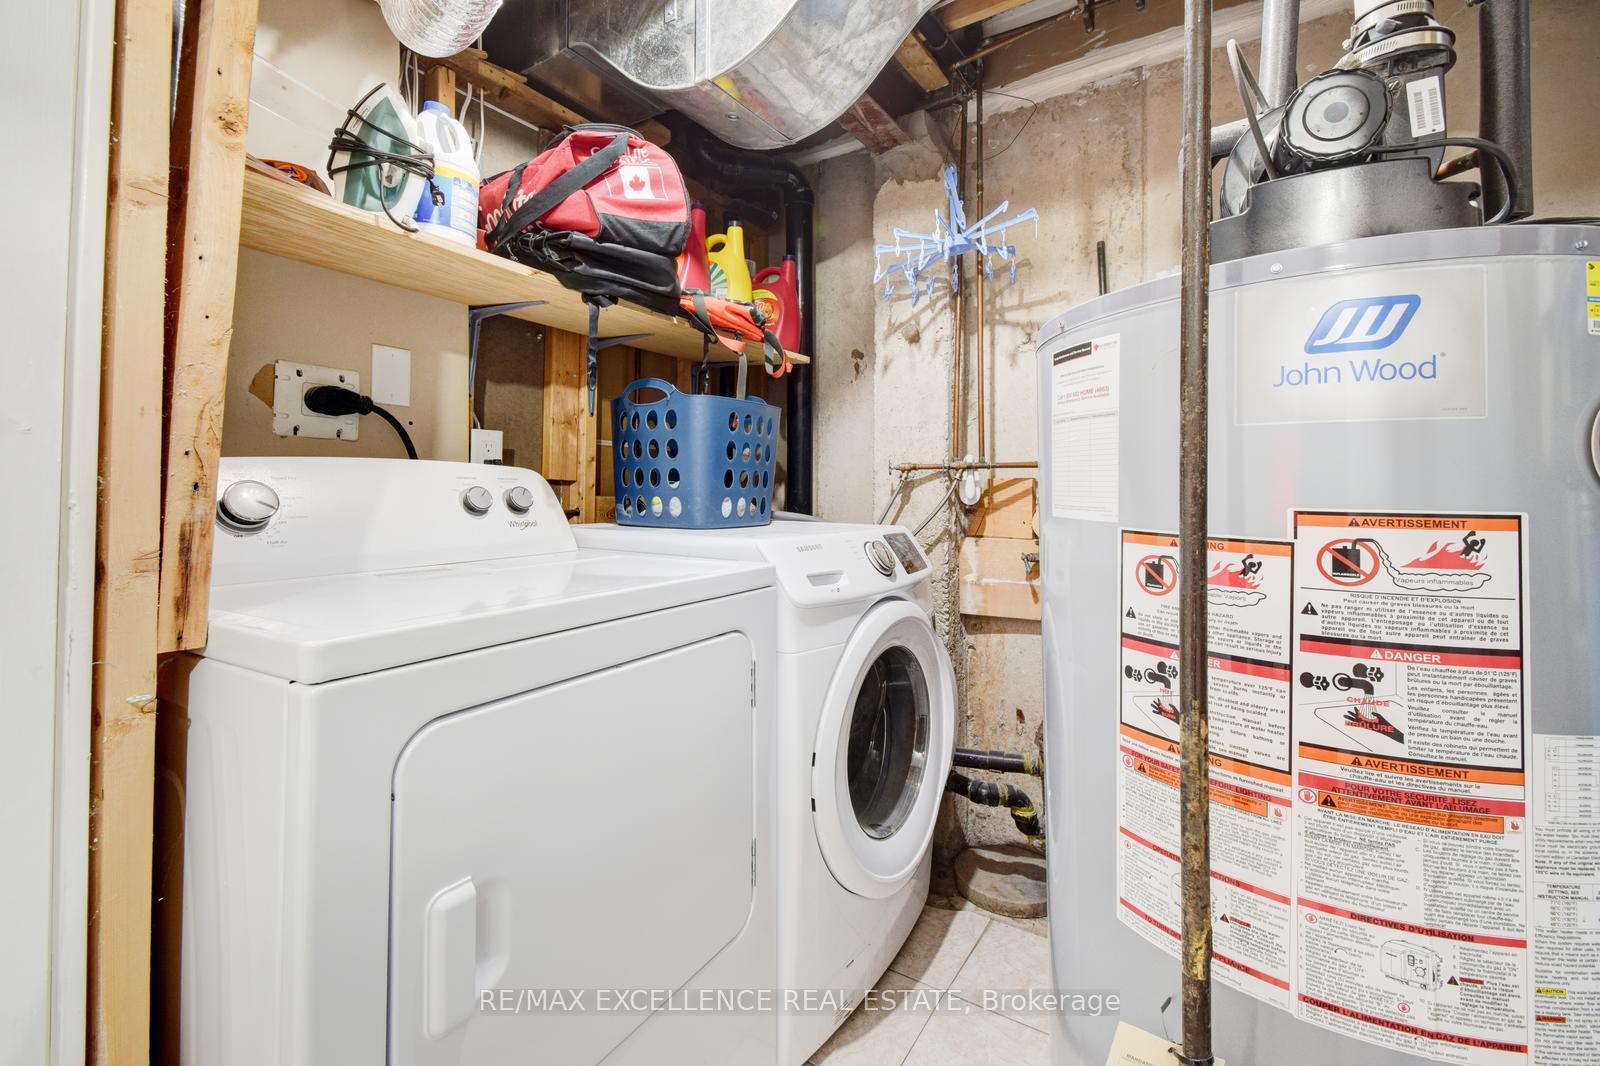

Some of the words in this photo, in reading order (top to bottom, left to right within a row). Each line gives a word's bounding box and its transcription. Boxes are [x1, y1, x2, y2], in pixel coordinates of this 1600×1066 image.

[1273, 362, 1341, 388] John
[1350, 355, 1437, 382] Wood
[508, 519, 538, 530] Whirlpool
[1362, 518, 1467, 529] AVERTISSEMENT
[796, 544, 824, 552] SAMSUNG
[1395, 576, 1424, 585] Vapeurs
[1384, 652, 1440, 663] DANGER
[1340, 766, 1363, 775] Veuillez
[1414, 777, 1462, 787] avertissements
[1365, 759, 1469, 779] AVERTISSEMENT
[1348, 773, 1386, 783] chauffe-eau
[1406, 780, 1436, 790] directives
[1331, 786, 1402, 804] ATTENTIVEMENT
[1405, 798, 1433, 808] AVANT
[1436, 802, 1490, 814] L'ALLUMAGE
[1345, 783, 1369, 794] POUR
[1372, 788, 1401, 799] VOTRE
[1403, 791, 1449, 806] SÉCURITÉ,
[1453, 798, 1476, 806] LISEZ
[1350, 912, 1405, 931] DIRECTIVES
[1408, 925, 1474, 942] D'UTILISATION
[1303, 996, 1339, 1014] COUPER
[1343, 1008, 1417, 1034] L'ALIMENTATION
[1420, 1028, 1433, 1038] EN
[1436, 1032, 1456, 1042] GAZ
[1458, 1036, 1470, 1045] DE
[1473, 1038, 1522, 1052] L'APPAREIL
